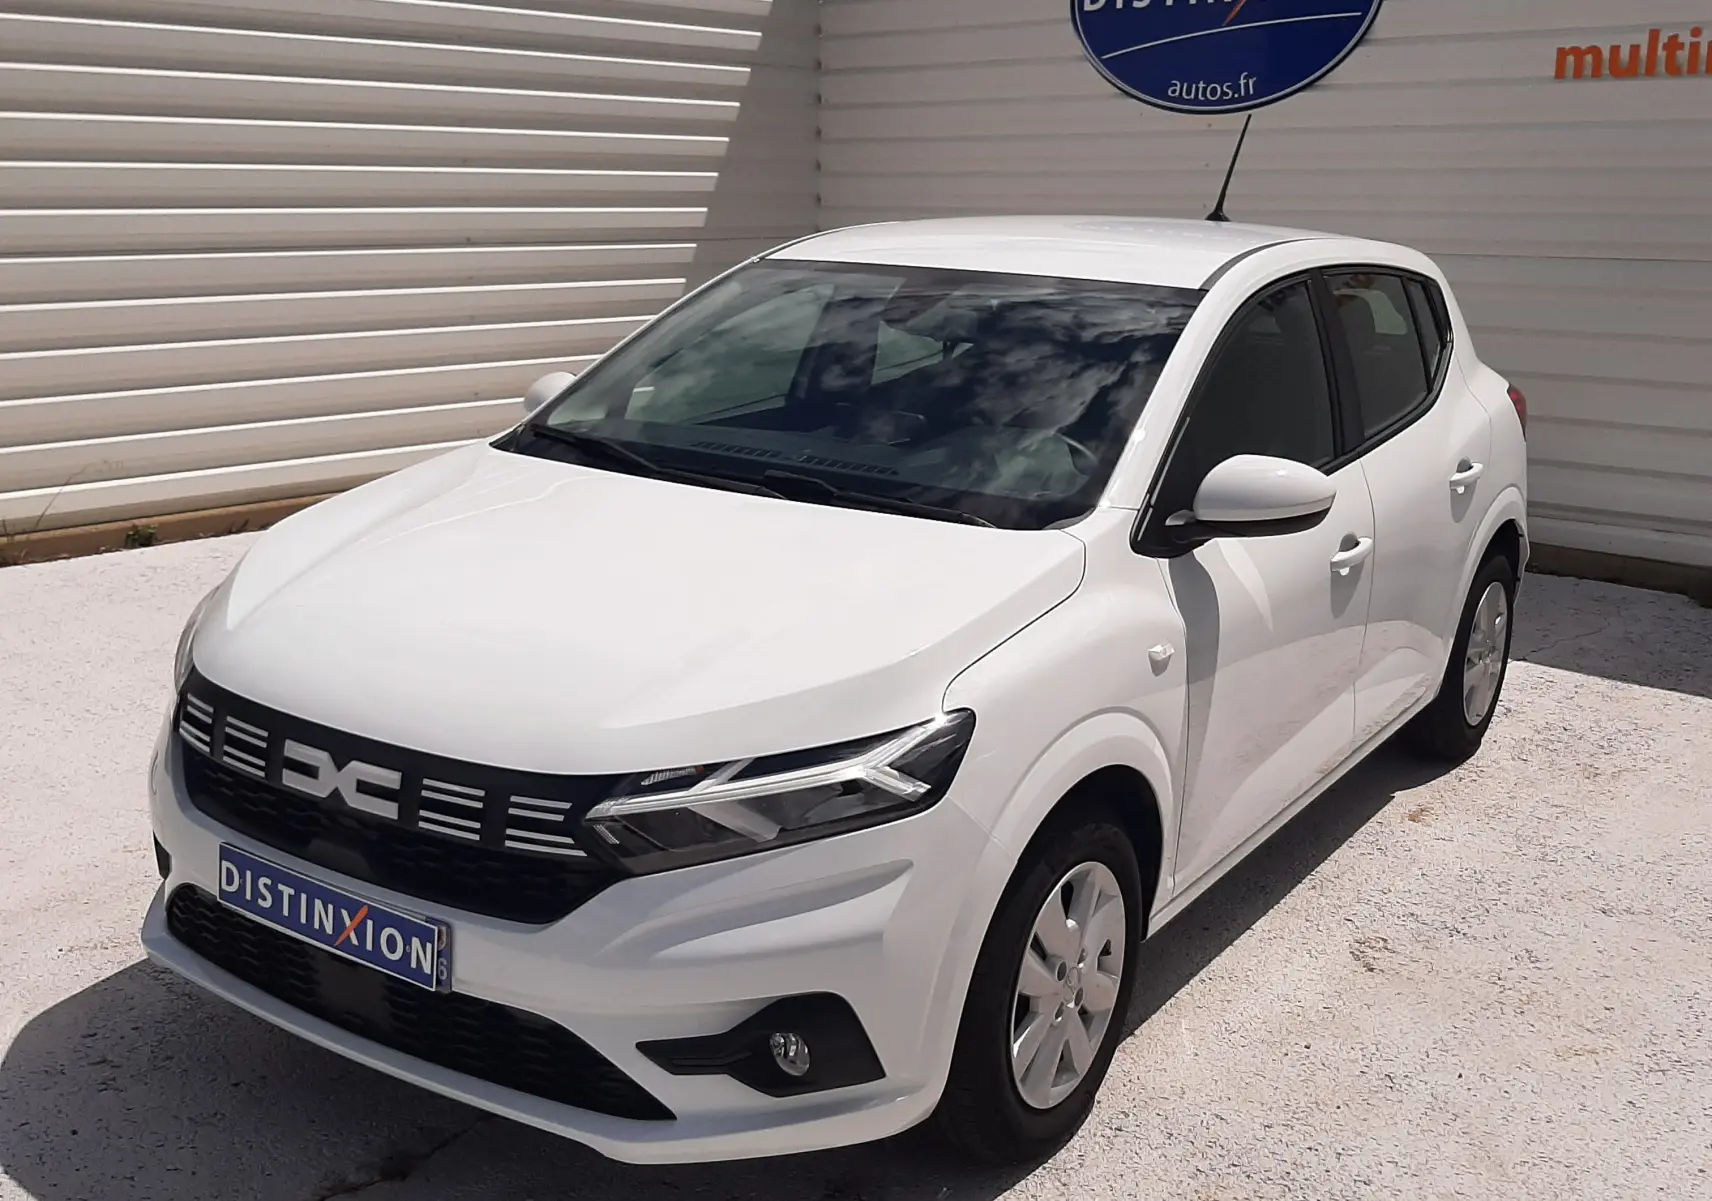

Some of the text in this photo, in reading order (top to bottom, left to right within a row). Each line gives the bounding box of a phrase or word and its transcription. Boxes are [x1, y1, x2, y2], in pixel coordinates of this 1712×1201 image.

[1554, 26, 1712, 80] multi
[1167, 72, 1257, 100] autos.fr
[221, 860, 433, 975] DISTINXION
